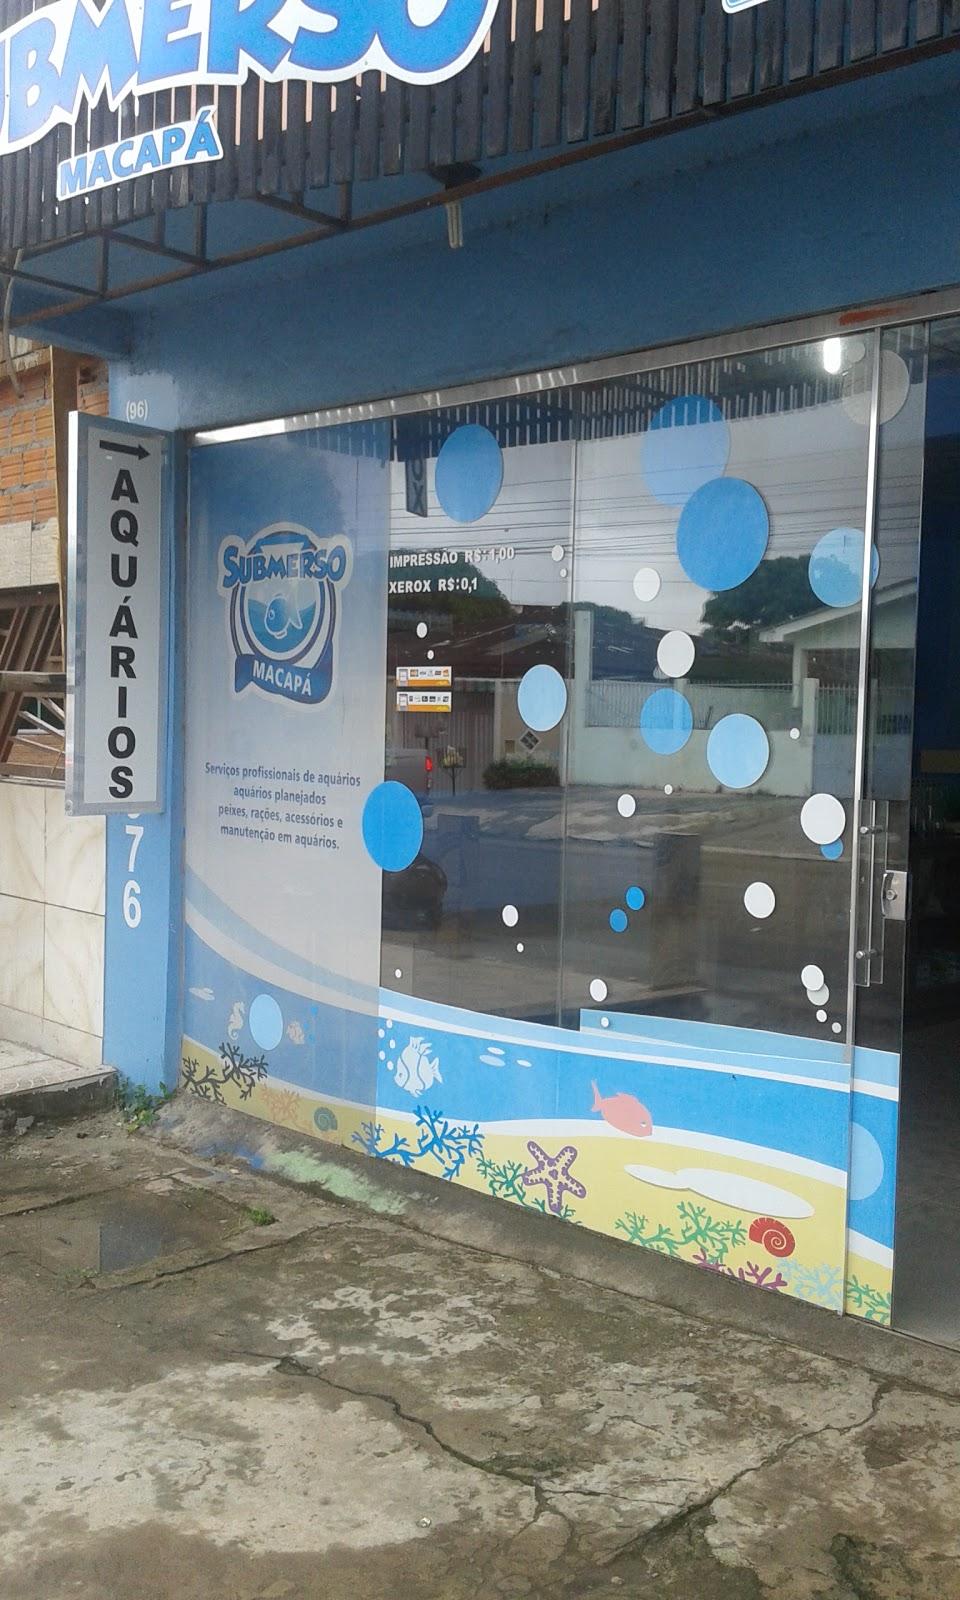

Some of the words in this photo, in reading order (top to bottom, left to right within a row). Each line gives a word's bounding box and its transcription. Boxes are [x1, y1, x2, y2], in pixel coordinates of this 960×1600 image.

[60, 110, 219, 196] MACAPÁ
[126, 400, 148, 422] (96)
[222, 545, 347, 588] SUBMERSO
[389, 548, 458, 568] IMPRESSÃO
[389, 580, 431, 593] XEROX
[438, 577, 478, 593] R$:0,1
[107, 468, 139, 799] AQUÁRIOS
[253, 660, 312, 696] MACAPÁ
[205, 762, 240, 777] Serviços
[242, 766, 300, 782] profissionais
[303, 770, 315, 782] de
[318, 772, 361, 787] aquários
[233, 786, 272, 800] aquários
[274, 789, 326, 805] planejados
[218, 804, 248, 818] peixes,
[250, 808, 282, 822] rações,
[285, 812, 334, 828] acessórios
[337, 818, 343, 828] e
[220, 824, 275, 843] manutenção
[278, 832, 292, 843] em
[295, 834, 340, 850] aquários.
